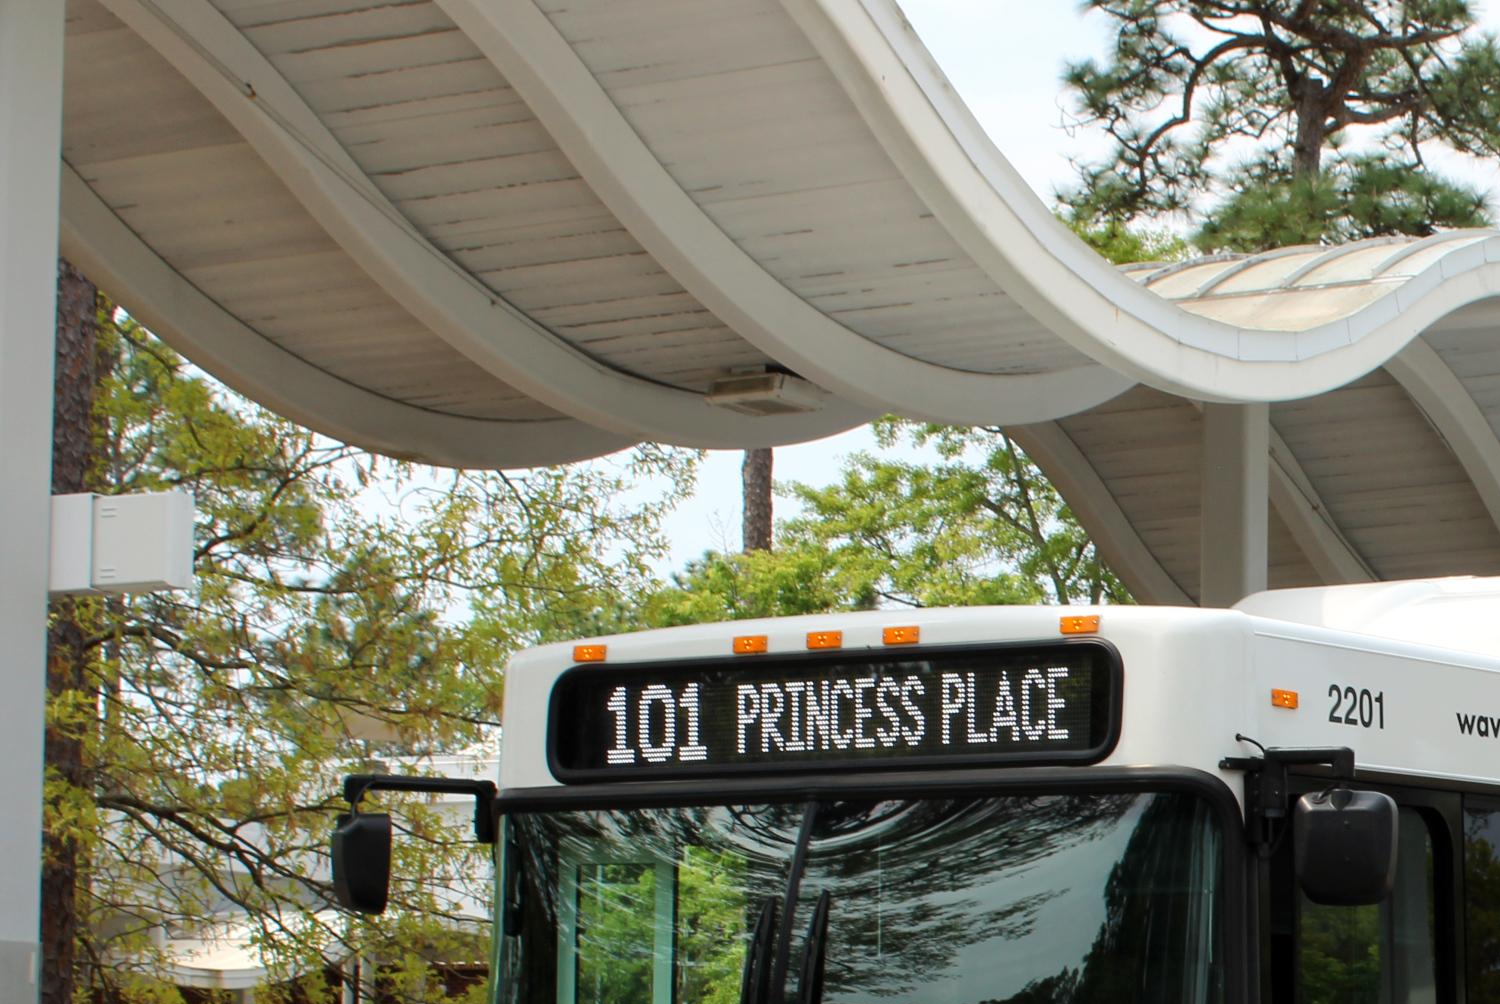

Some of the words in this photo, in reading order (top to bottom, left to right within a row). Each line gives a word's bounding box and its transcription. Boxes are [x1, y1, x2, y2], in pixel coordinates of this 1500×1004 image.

[607, 683, 707, 764] 101
[738, 675, 925, 754] PRINCESS
[941, 666, 1068, 745] PLACE
[1328, 684, 1385, 729] 2201
